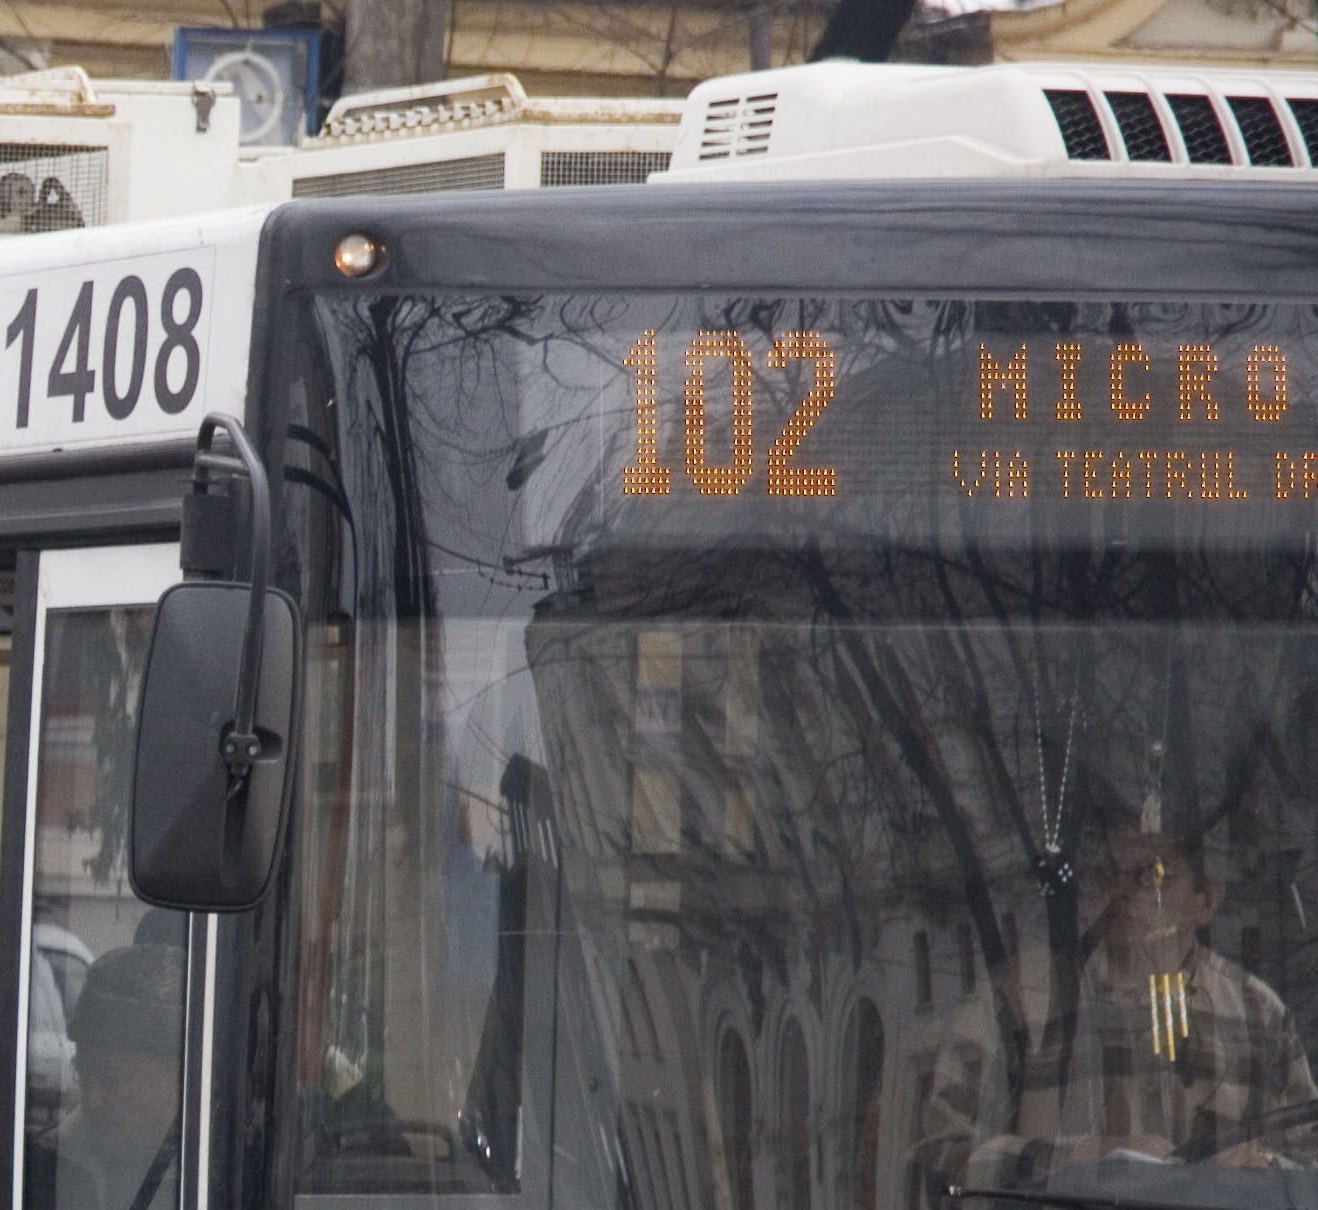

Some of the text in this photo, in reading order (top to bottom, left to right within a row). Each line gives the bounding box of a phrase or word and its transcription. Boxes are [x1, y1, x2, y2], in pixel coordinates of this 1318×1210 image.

[4, 266, 204, 430] 1408
[979, 342, 1289, 421] MICRO
[622, 328, 838, 497] 102
[952, 449, 1030, 499] VIA
[1055, 450, 1249, 499] TEATRUL
